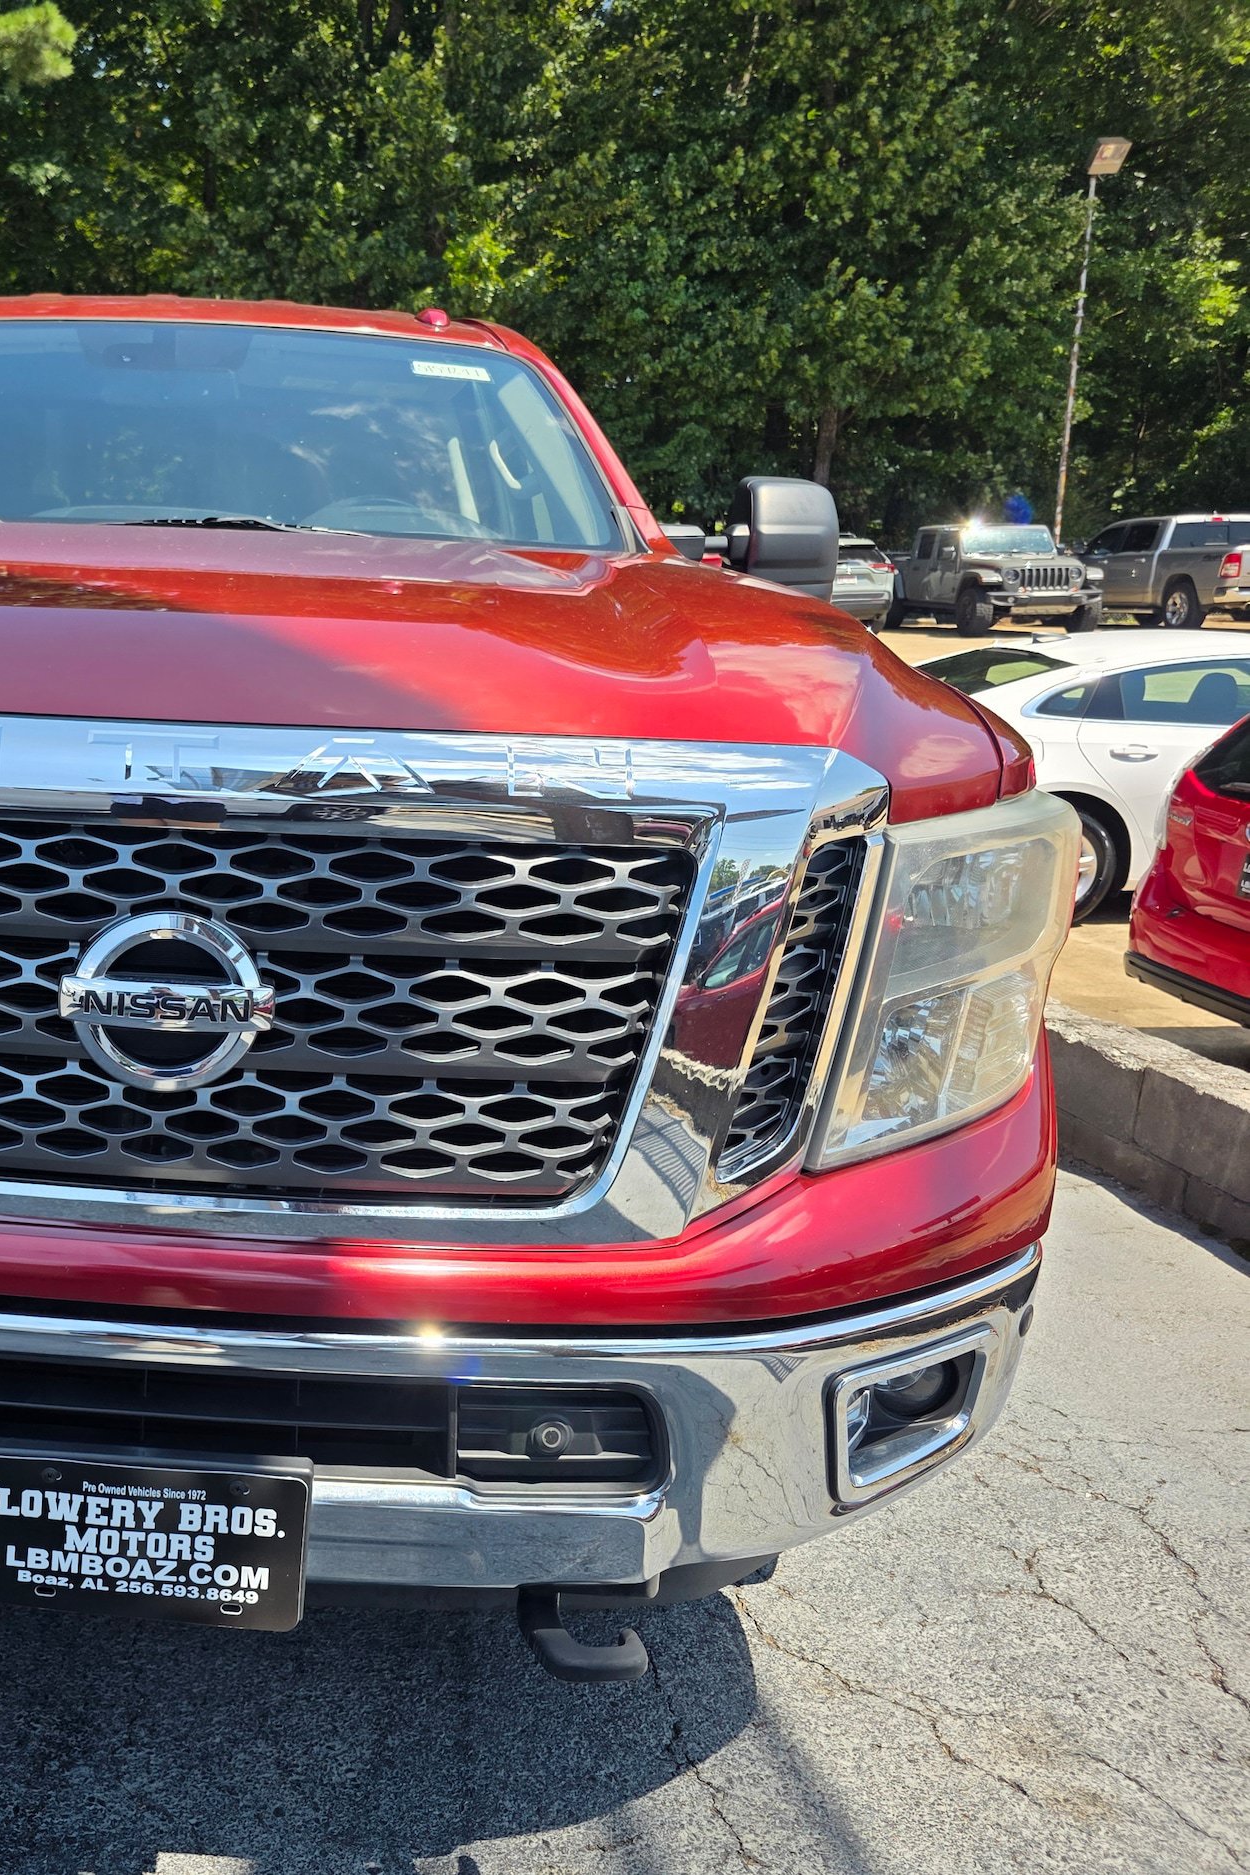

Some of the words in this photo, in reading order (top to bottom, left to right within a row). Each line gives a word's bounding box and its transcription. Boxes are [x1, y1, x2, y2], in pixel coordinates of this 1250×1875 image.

[82, 989, 251, 1023] NISSAN
[82, 1481, 97, 1493] Pre
[98, 1483, 127, 1496] Owned
[128, 1485, 162, 1498] Vehicles
[163, 1488, 186, 1500] Since
[188, 1489, 207, 1501] 1972
[177, 1503, 286, 1539] BROS.
[64, 1524, 216, 1562] MOTORS
[6, 1545, 270, 1590] LBMBOAZ.COM
[17, 1569, 74, 1589] Boaz,
[80, 1577, 109, 1592] AL
[115, 1580, 259, 1605] 256.593.8649
